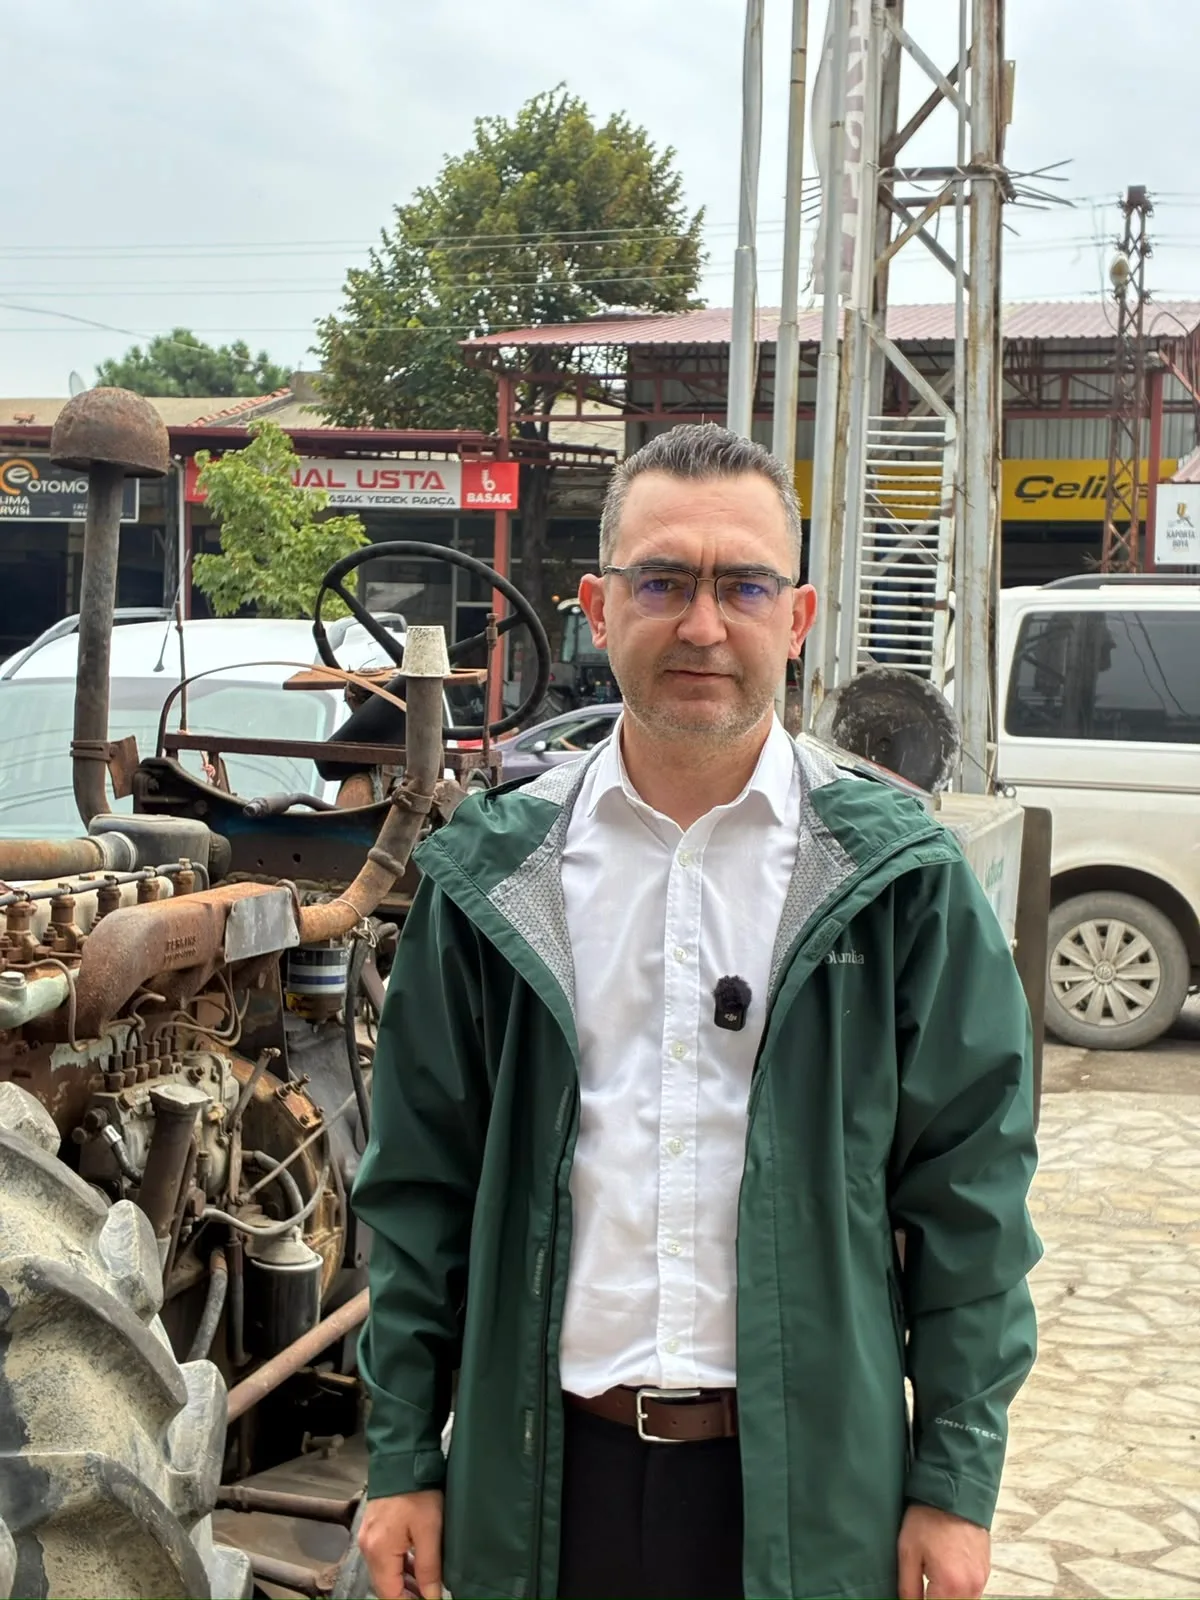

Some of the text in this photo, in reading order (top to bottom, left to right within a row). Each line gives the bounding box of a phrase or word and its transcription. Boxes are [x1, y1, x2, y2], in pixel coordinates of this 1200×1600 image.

[357, 469, 445, 490] USTA
[369, 495, 408, 504] YEDEK
[412, 496, 456, 507] PARÇA
